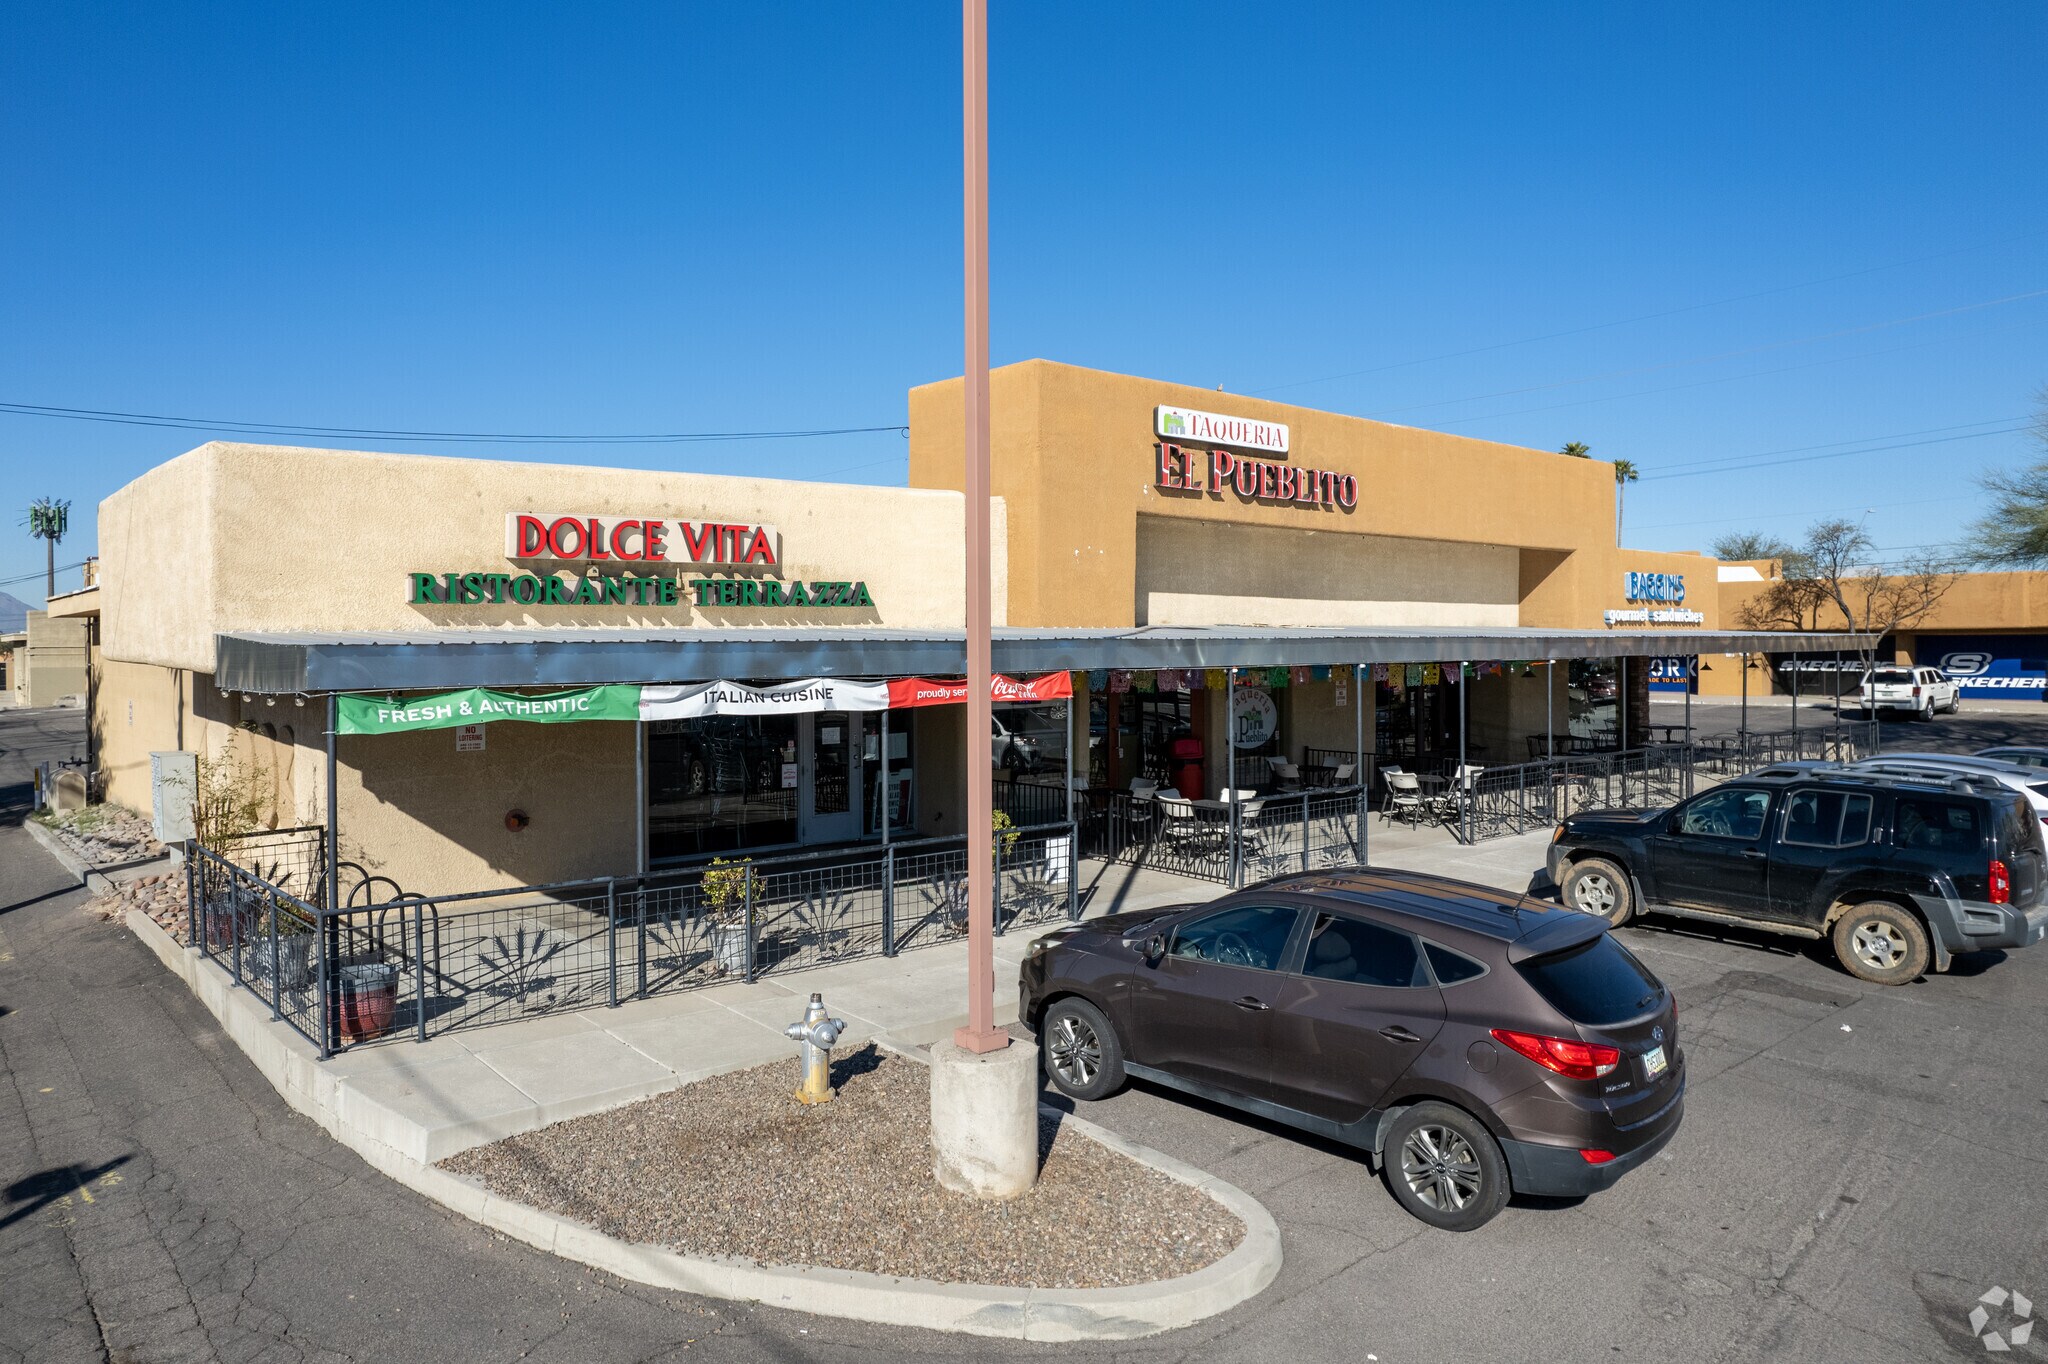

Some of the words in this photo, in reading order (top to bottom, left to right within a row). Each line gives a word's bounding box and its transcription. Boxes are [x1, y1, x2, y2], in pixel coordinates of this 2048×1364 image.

[1187, 413, 1284, 448] TAQUERIA
[1157, 442, 1203, 491] EL
[1210, 450, 1359, 507] PUEBLITO
[516, 514, 666, 561] DOLCE
[680, 521, 777, 565] VITA
[408, 572, 678, 607] RISTORANTE
[693, 580, 876, 608] TERRAZZA
[1606, 608, 1648, 624] gourmet
[1652, 607, 1704, 623] sandwiches
[1650, 658, 1698, 677] ORK
[1951, 677, 2048, 688] SKECHER
[703, 690, 766, 705] ITALIAN
[769, 687, 834, 704] CUISINE
[917, 687, 951, 700] proudly
[952, 688, 968, 697] ser
[1233, 690, 1271, 714] aqueria
[378, 704, 452, 725] FRESH
[459, 701, 474, 716] &
[479, 697, 590, 716] AUTHENTIC
[458, 734, 483, 742] LOITERING
